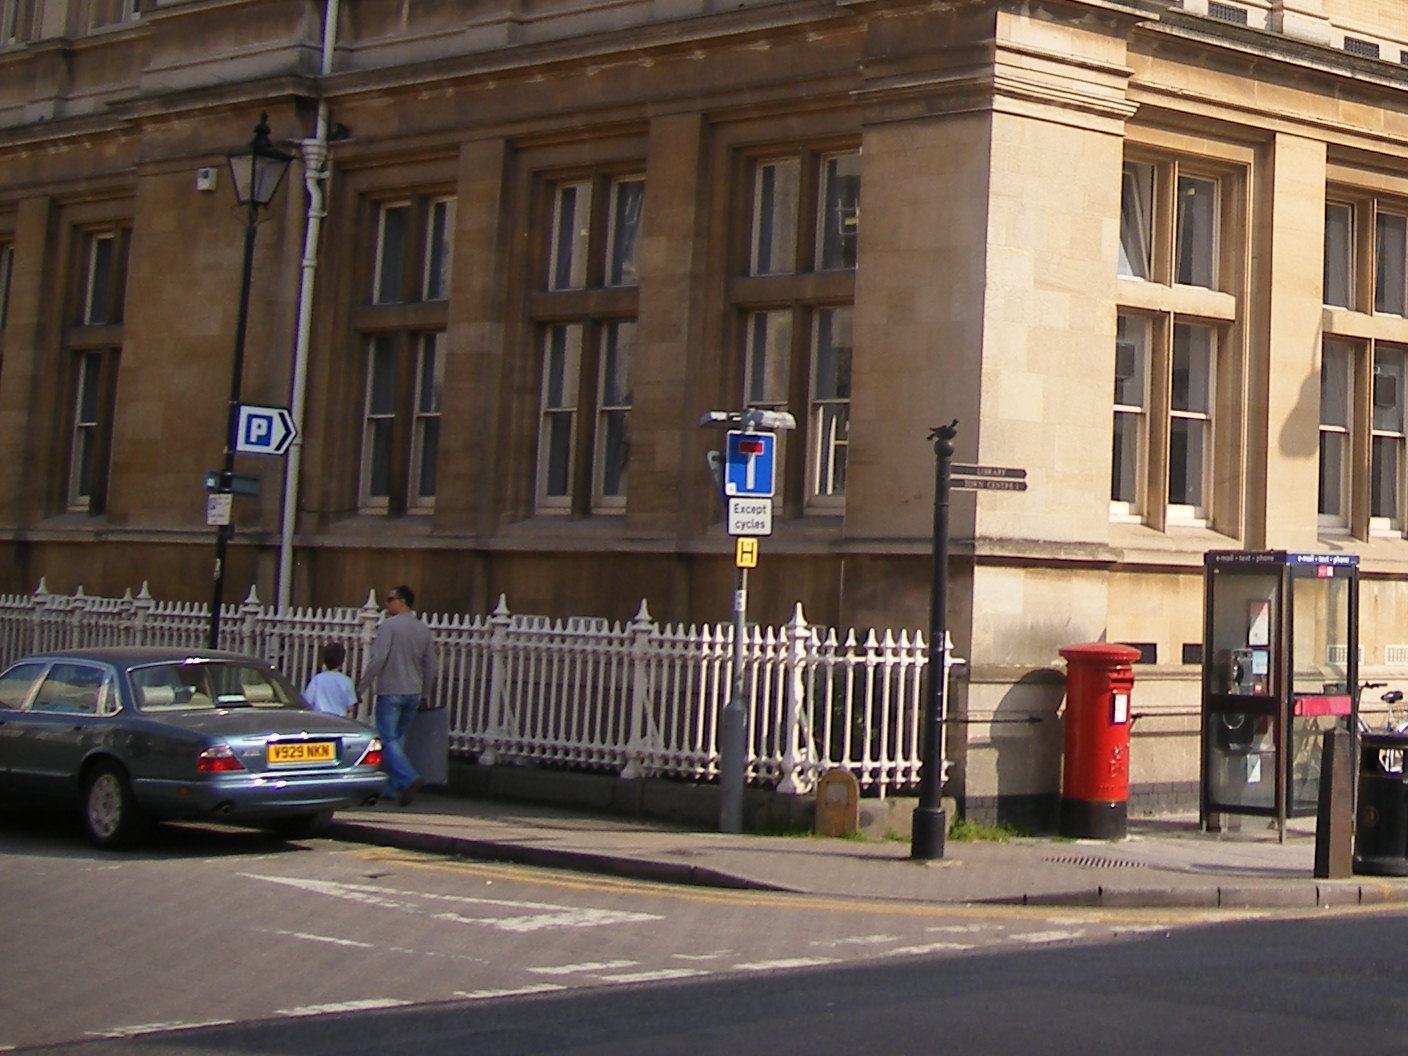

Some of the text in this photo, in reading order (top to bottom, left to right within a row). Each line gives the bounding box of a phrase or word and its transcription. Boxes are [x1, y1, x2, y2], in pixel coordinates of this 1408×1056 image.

[250, 417, 268, 443] P
[734, 503, 767, 515] Except
[735, 518, 766, 531] cycles
[740, 540, 754, 564] H
[1215, 554, 1275, 563] e-mail text phone
[1297, 554, 1350, 565] e-mail text phone
[273, 745, 304, 759] V929
[307, 744, 330, 758] NKN
